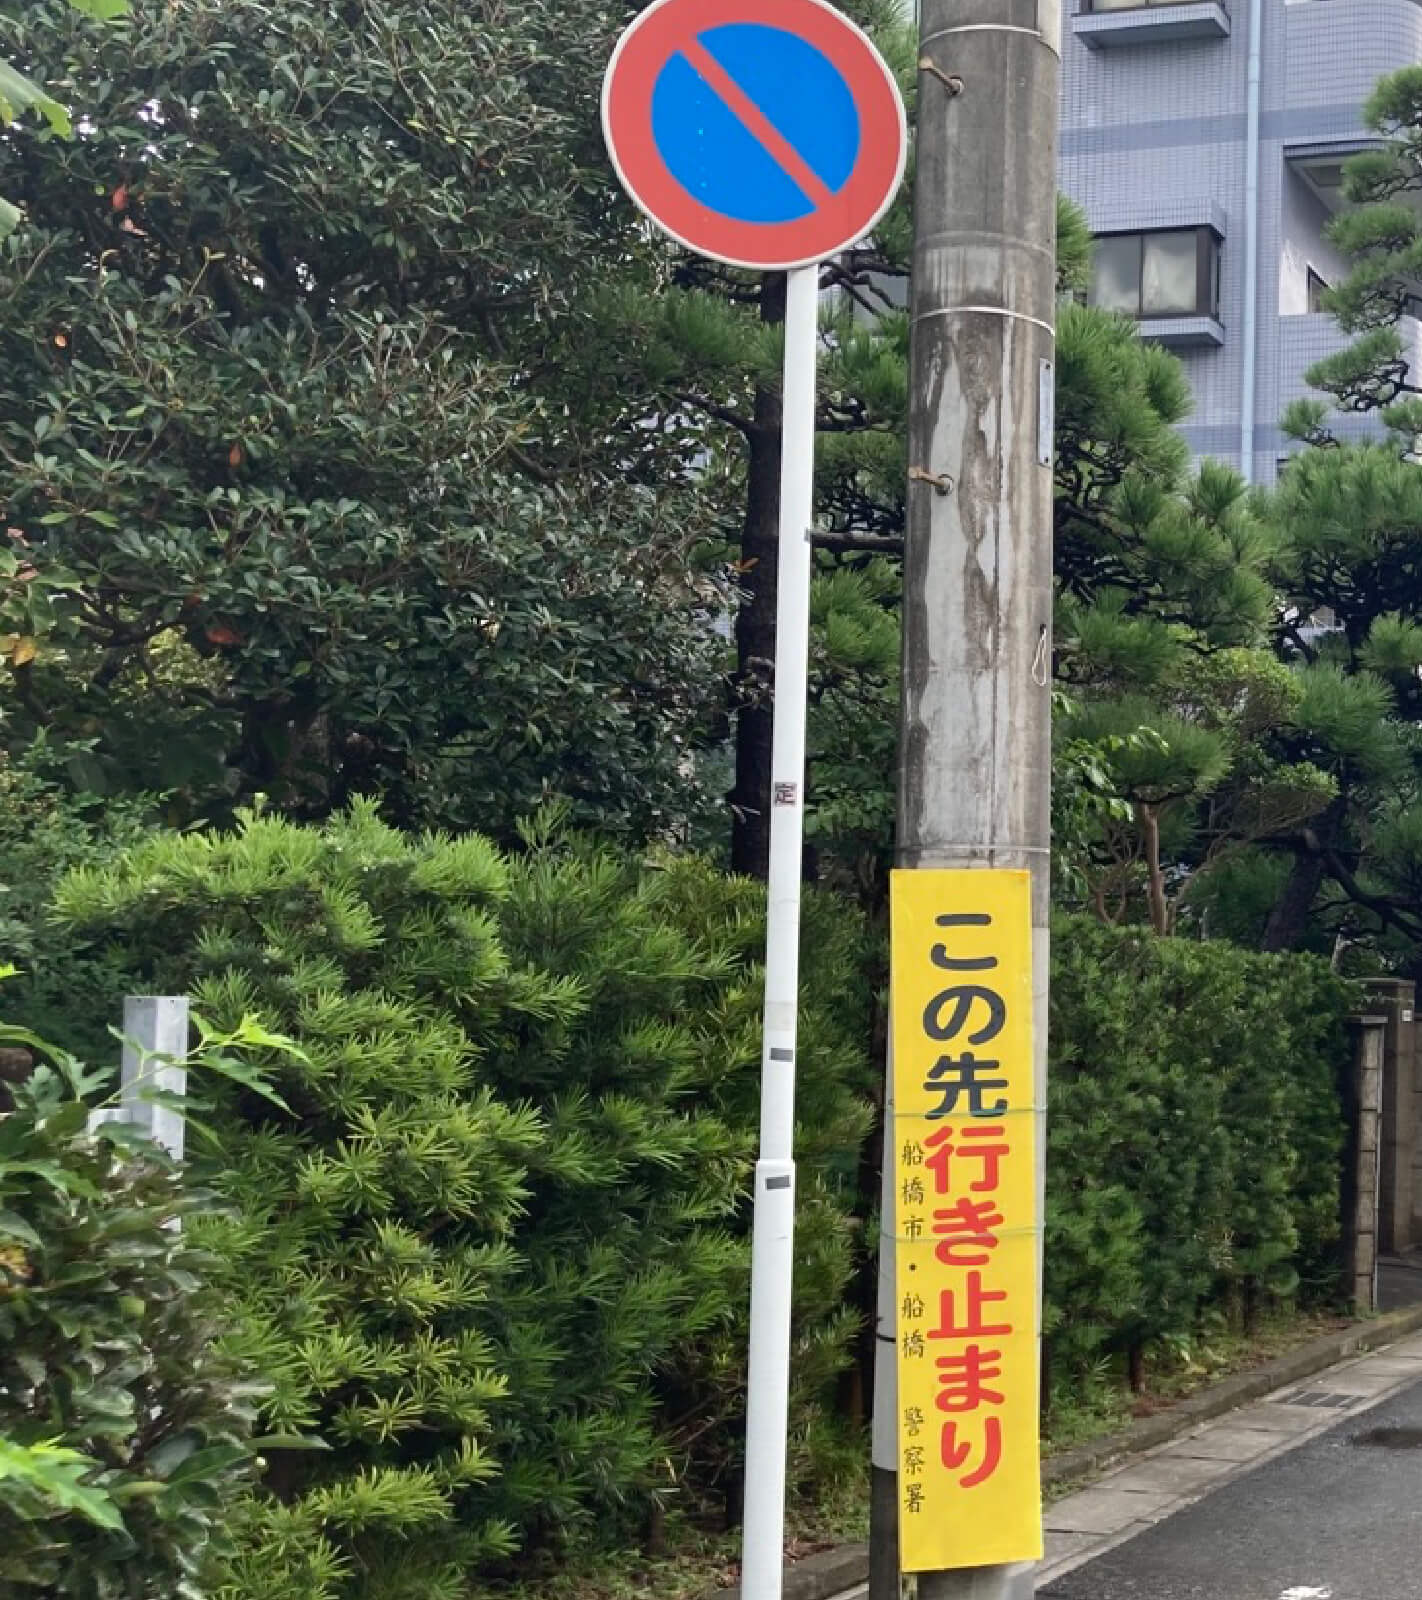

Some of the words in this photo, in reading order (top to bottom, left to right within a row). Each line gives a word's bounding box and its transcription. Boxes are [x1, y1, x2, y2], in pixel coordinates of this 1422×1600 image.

[923, 913, 1012, 1488] この先行き止まり
